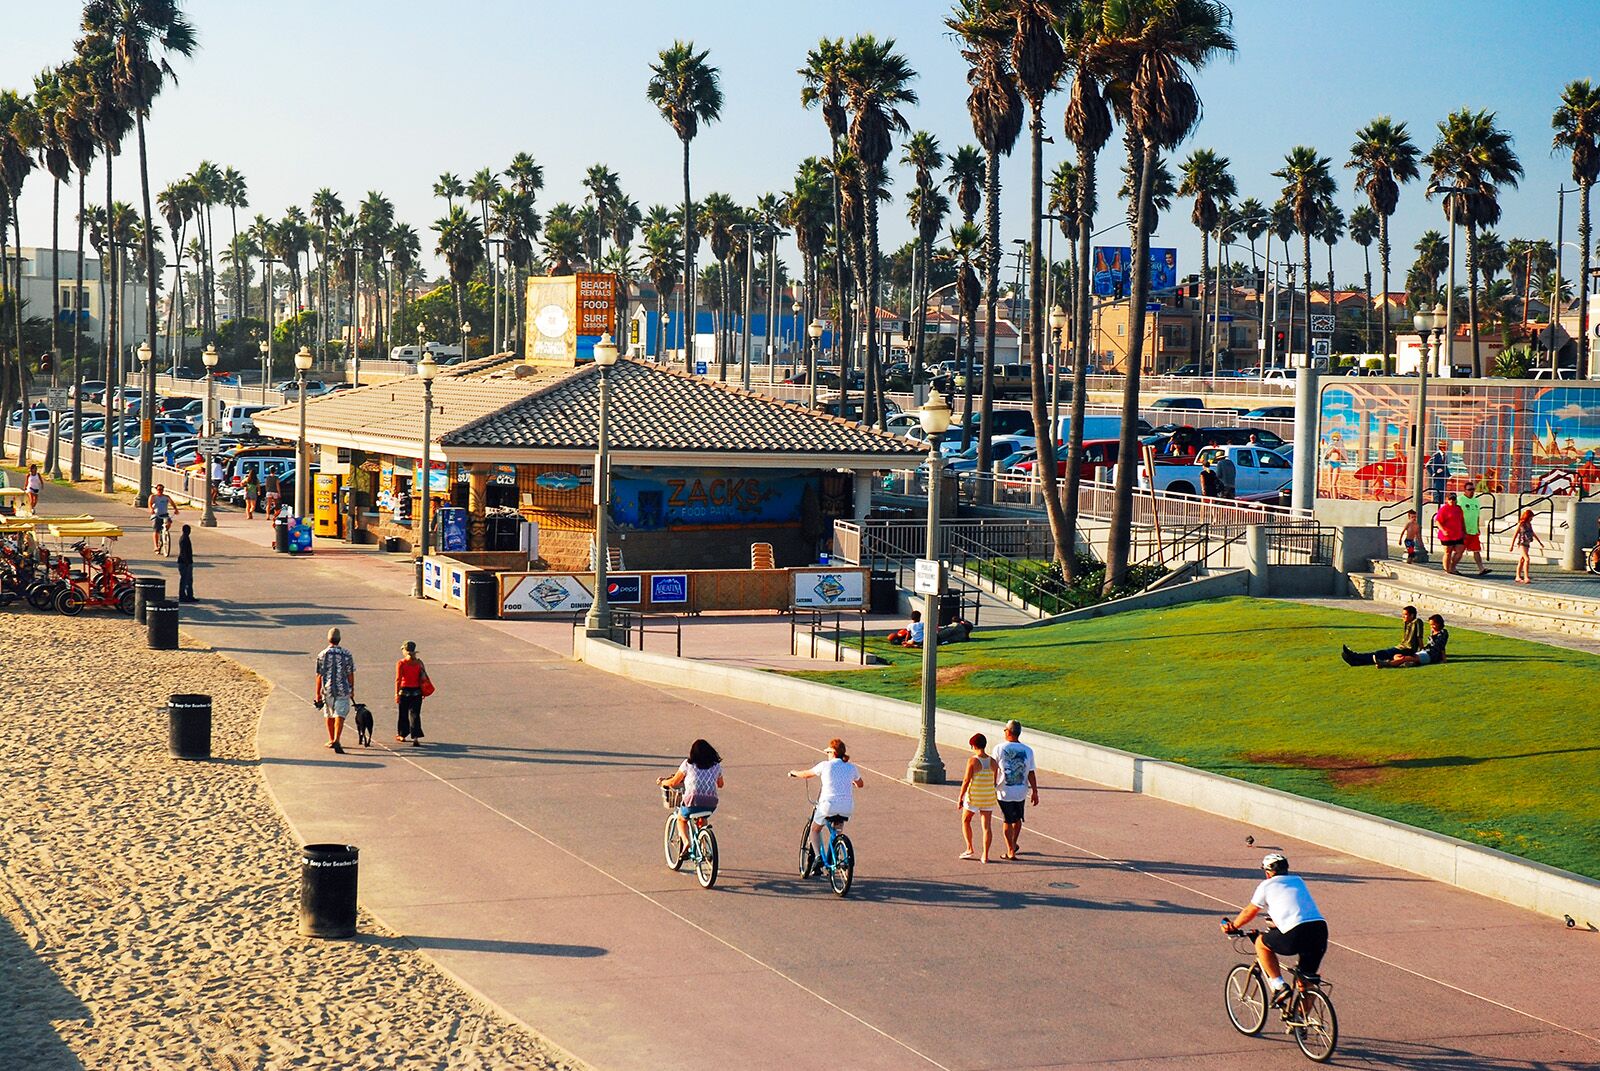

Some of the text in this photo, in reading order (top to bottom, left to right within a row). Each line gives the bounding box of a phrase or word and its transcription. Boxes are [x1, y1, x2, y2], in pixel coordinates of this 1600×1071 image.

[581, 281, 611, 289] BEACH
[583, 301, 608, 309] FOOD
[583, 314, 607, 322] SURF
[457, 473, 470, 482] SU
[668, 479, 760, 506] ZACKS
[682, 507, 705, 516] FOOD
